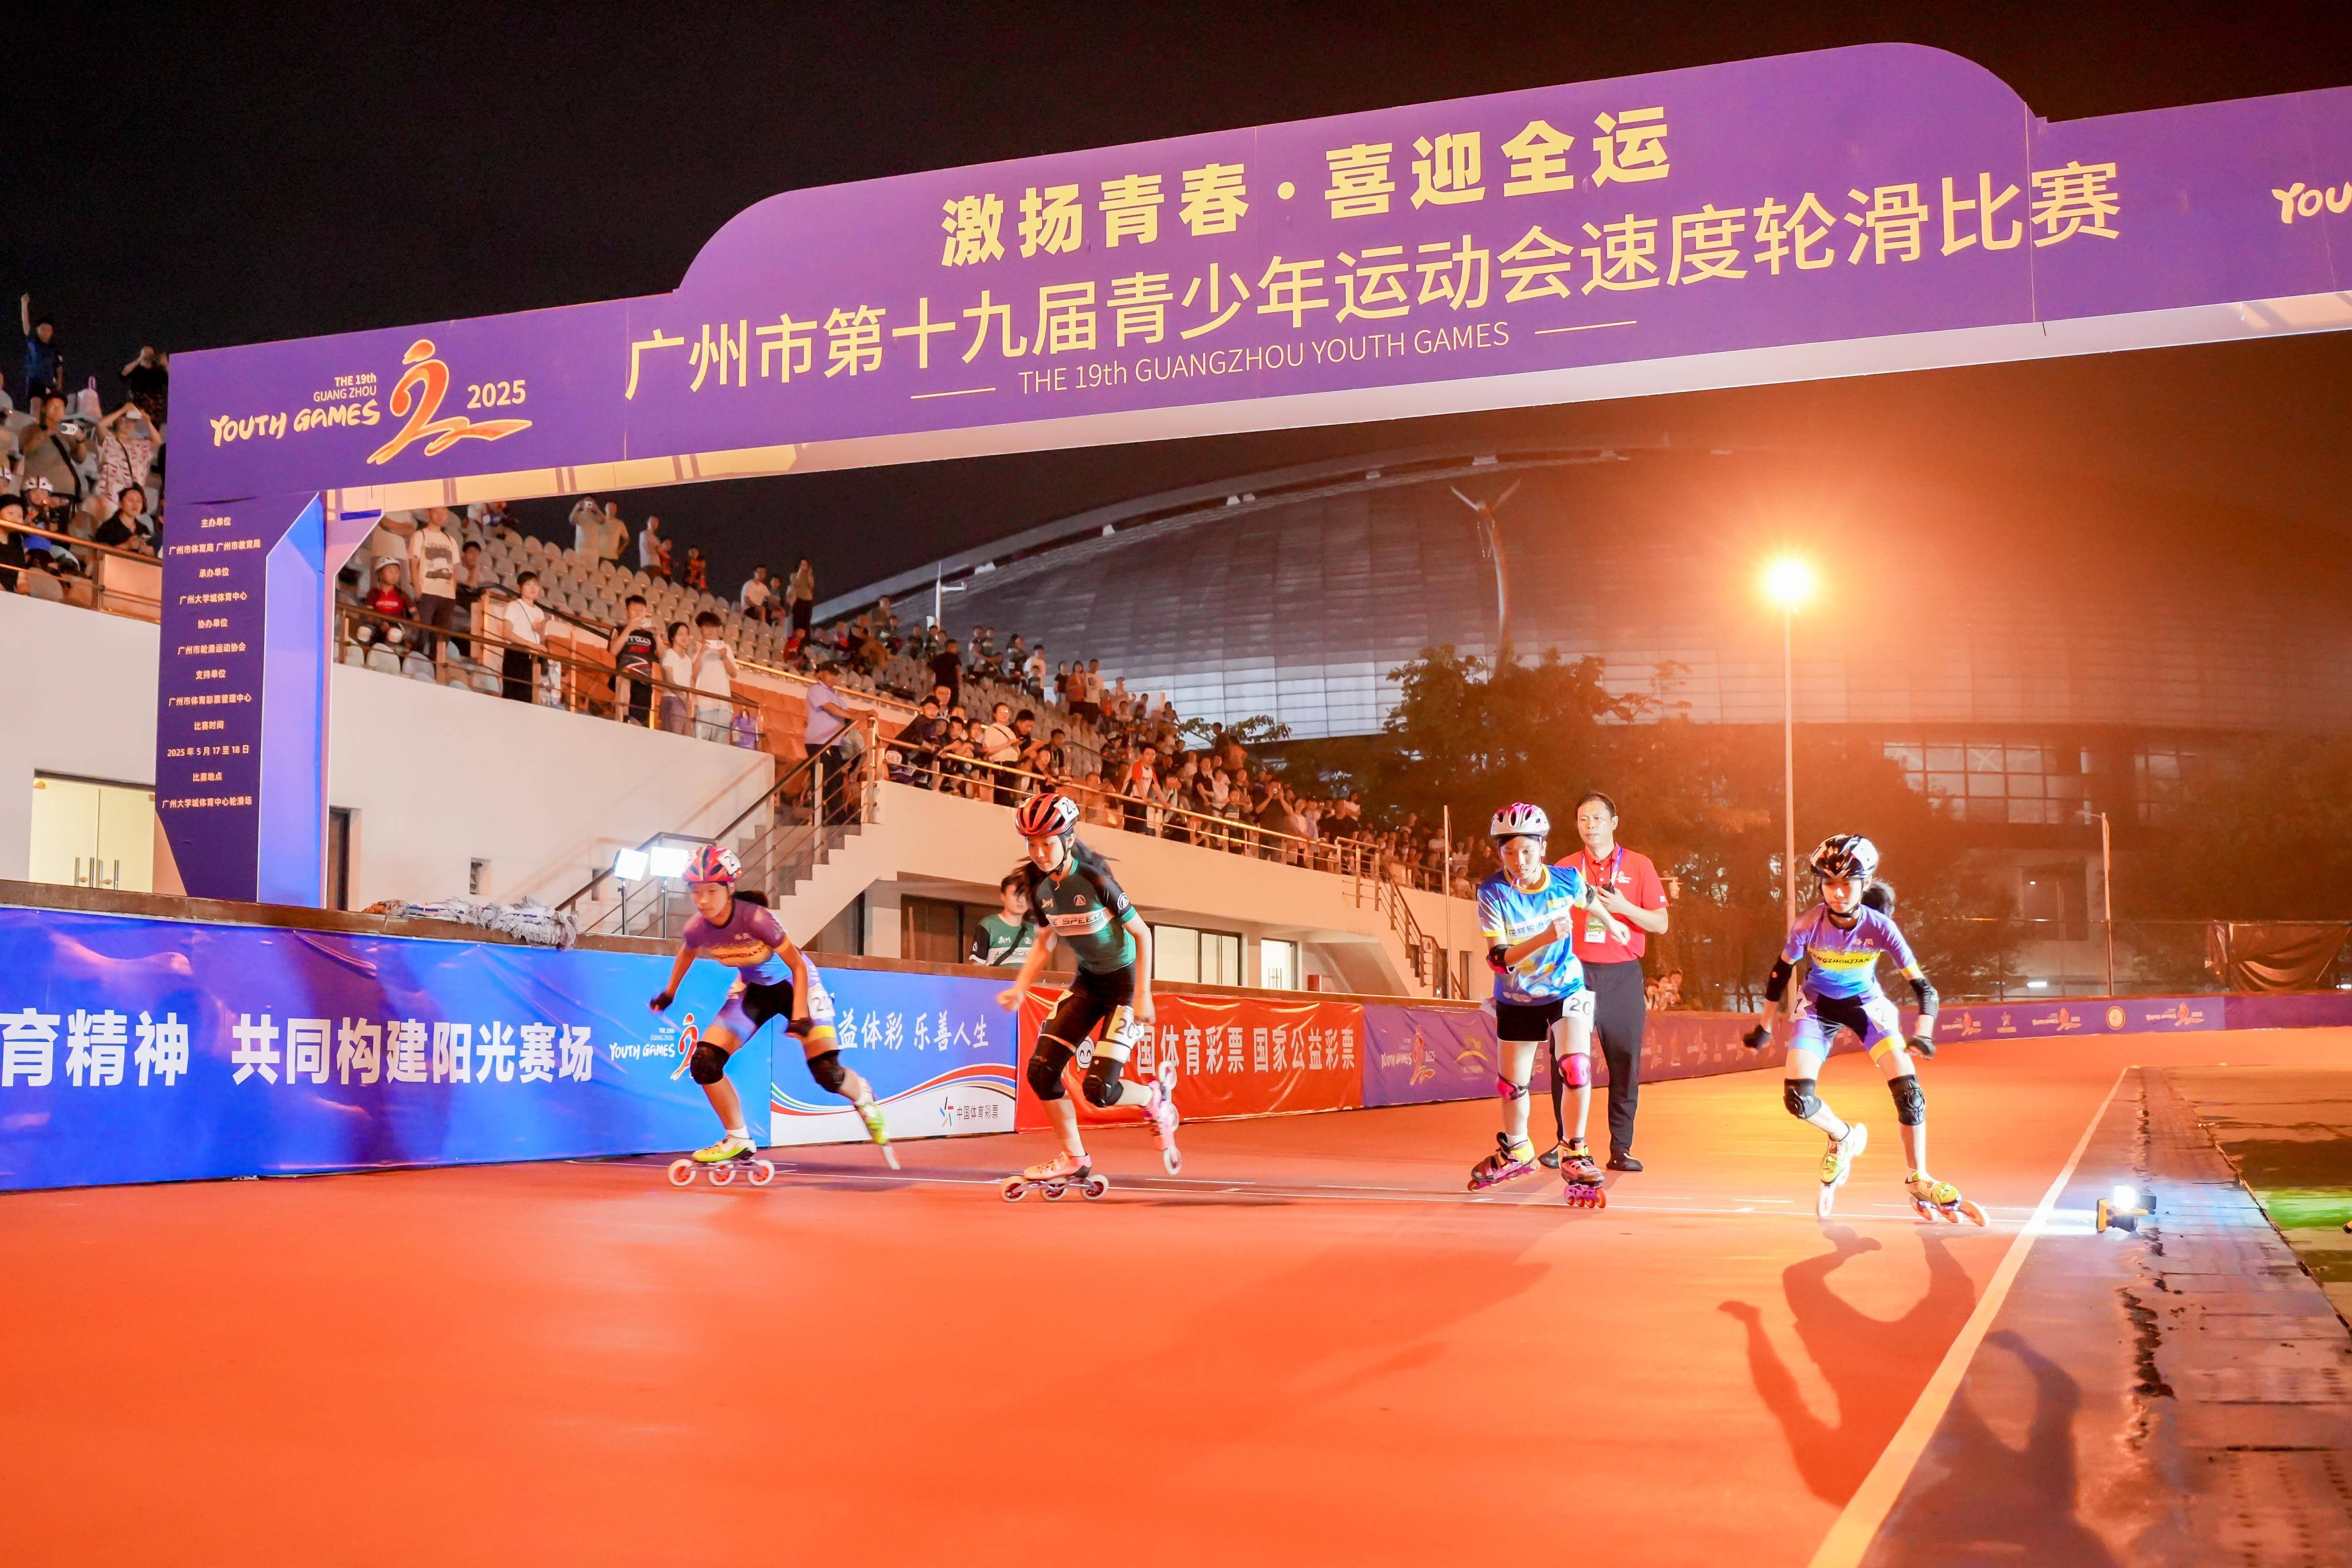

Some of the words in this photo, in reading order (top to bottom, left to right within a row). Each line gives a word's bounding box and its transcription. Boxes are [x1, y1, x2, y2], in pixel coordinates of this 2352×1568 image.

[625, 160, 2120, 400] 广州市第十九届青少年运动会速度轮滑比赛
[1019, 366, 1067, 394] THE
[1076, 360, 1127, 388] 19th
[1135, 345, 1303, 382] GUANGZHOU
[1311, 332, 1405, 364] YOUTH
[1414, 321, 1509, 354] GAMES
[335, 375, 353, 387] THE
[355, 372, 377, 385] 19th
[314, 388, 347, 402] GUANG
[349, 384, 377, 398] ZHOU
[467, 379, 526, 409] 2025
[210, 412, 287, 447] YOUTH
[293, 399, 381, 432] GAMES
[201, 516, 232, 528] 主办单位
[168, 543, 214, 555] 广州市体育局
[216, 539, 261, 552] 广州市教育局
[199, 567, 229, 578] 承办单位
[179, 591, 248, 605] 广州大学城体育中心
[198, 618, 228, 629] 协办单位
[177, 642, 246, 655] 广州市轮滑运动协会
[195, 668, 226, 680] 支持单位
[194, 720, 224, 731] 比赛时间
[167, 748, 185, 757] 2025
[187, 747, 194, 756] 年
[197, 747, 201, 756] 5
[203, 746, 210, 756] 月
[212, 746, 221, 755] 17
[222, 745, 229, 755] 至
[231, 745, 240, 754] 18
[242, 744, 249, 754] 日
[192, 771, 223, 782] 比赛地点
[162, 795, 252, 809] 广州大学城体育中心轮滑场
[914, 1009, 988, 1052] 乐善人生
[0, 1008, 189, 1087] 育精神
[232, 1013, 594, 1086] 共同构建阳光赛场
[609, 1042, 640, 1061] YOUTH
[642, 1043, 675, 1058] GAMES
[1120, 1024, 1244, 1077] 国体育彩票
[1253, 1027, 1355, 1073] 国家公益彩票
[956, 1104, 999, 1121] 中国体育彩票
